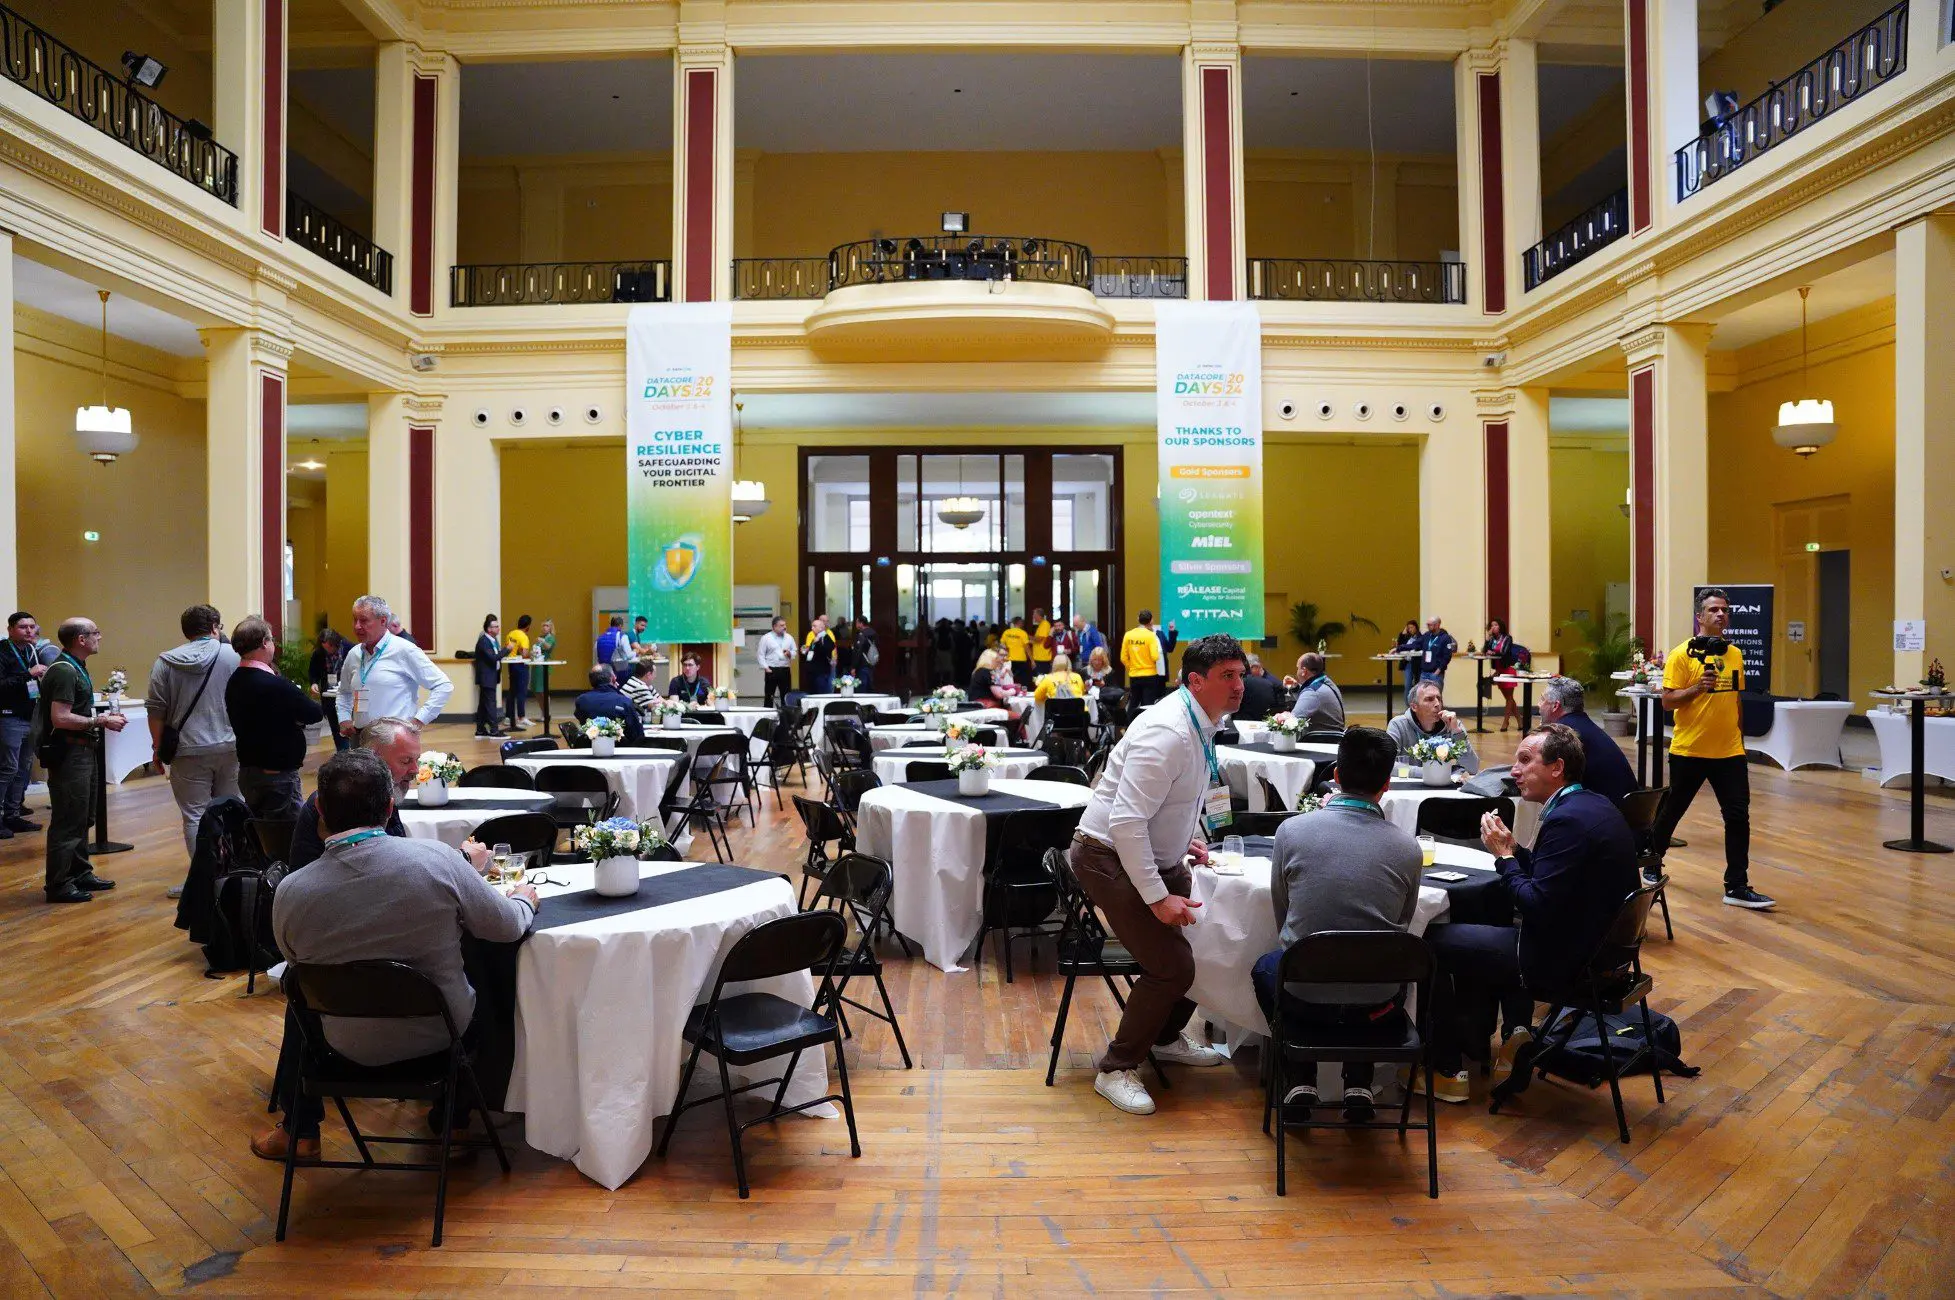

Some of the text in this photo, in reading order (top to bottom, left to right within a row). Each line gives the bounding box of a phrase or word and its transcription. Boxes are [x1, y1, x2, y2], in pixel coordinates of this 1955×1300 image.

[646, 376, 714, 387] DATACORE 20
[1177, 373, 1245, 384] DATACORE 20
[643, 384, 712, 398] DAYS 24
[1174, 381, 1242, 395] DAYS 24
[1176, 426, 1241, 435] THANKS TO
[654, 430, 703, 441] CYBER
[1165, 437, 1255, 446] OUR SPONSORS
[637, 444, 721, 456] RESILIENCE
[638, 458, 721, 467] SAFEGUARDING
[643, 468, 717, 477] YOUR DIGITAL
[1202, 468, 1243, 477] Sponsors
[653, 479, 705, 487] FRONTIER
[1188, 510, 1234, 519] opentext
[1179, 562, 1245, 572] Silver Sponsors
[1729, 604, 1761, 612] TAN
[1192, 608, 1243, 618] TITAN
